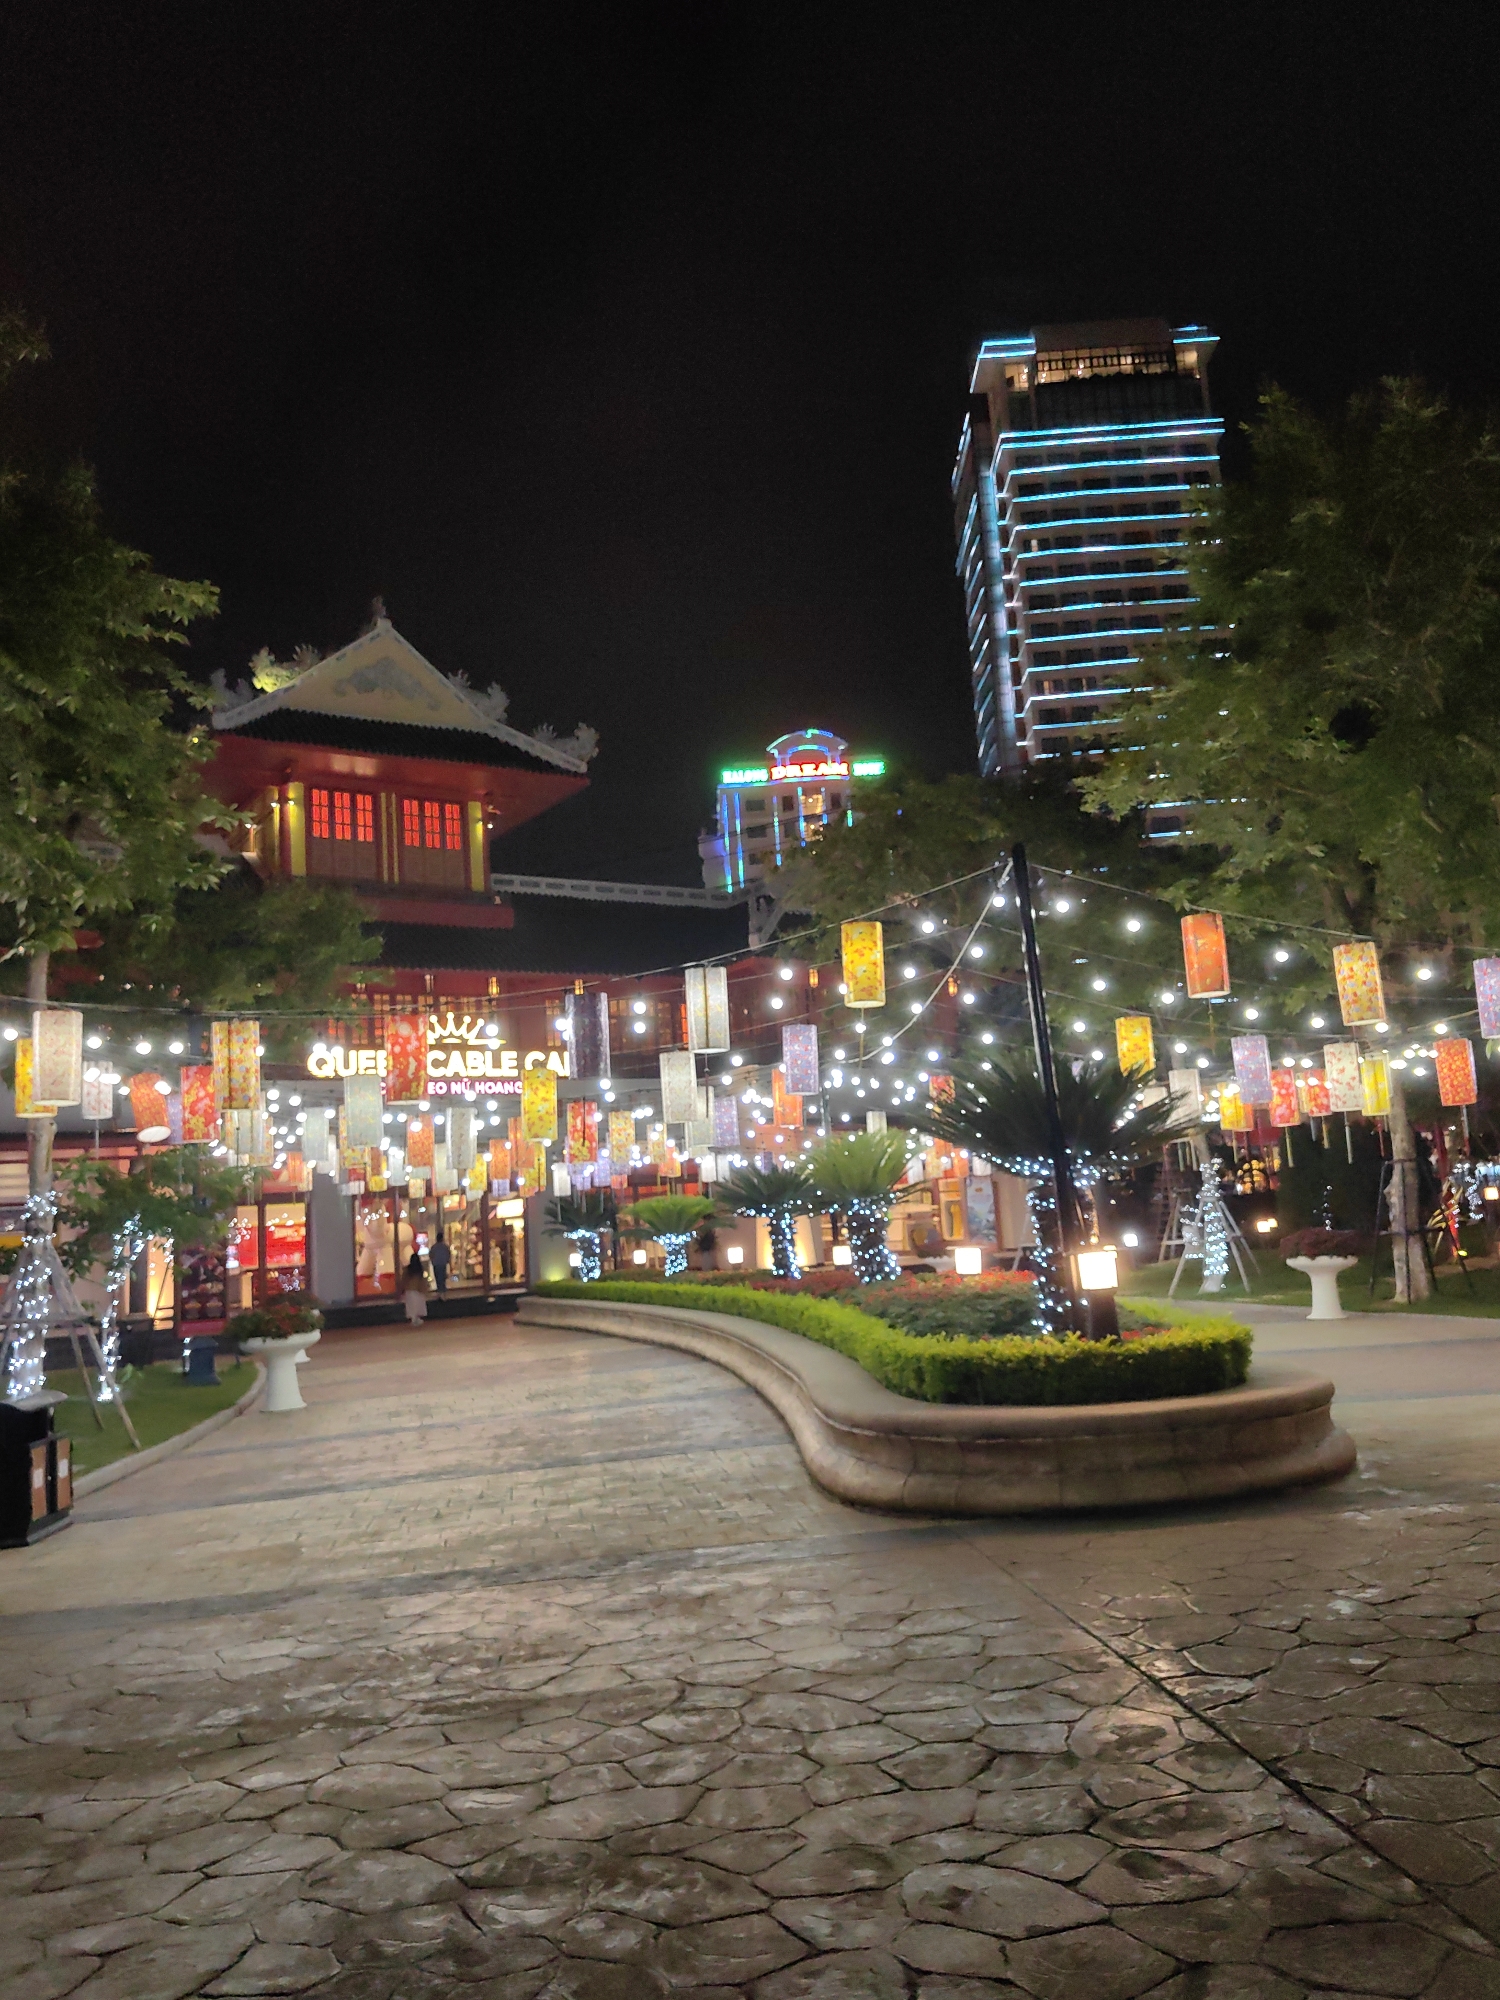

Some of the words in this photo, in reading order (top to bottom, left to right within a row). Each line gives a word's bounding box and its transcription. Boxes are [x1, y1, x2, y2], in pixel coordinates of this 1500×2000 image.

[771, 761, 849, 780] DREAM
[307, 1049, 388, 1078] QUEE
[427, 1050, 519, 1077] CABLE
